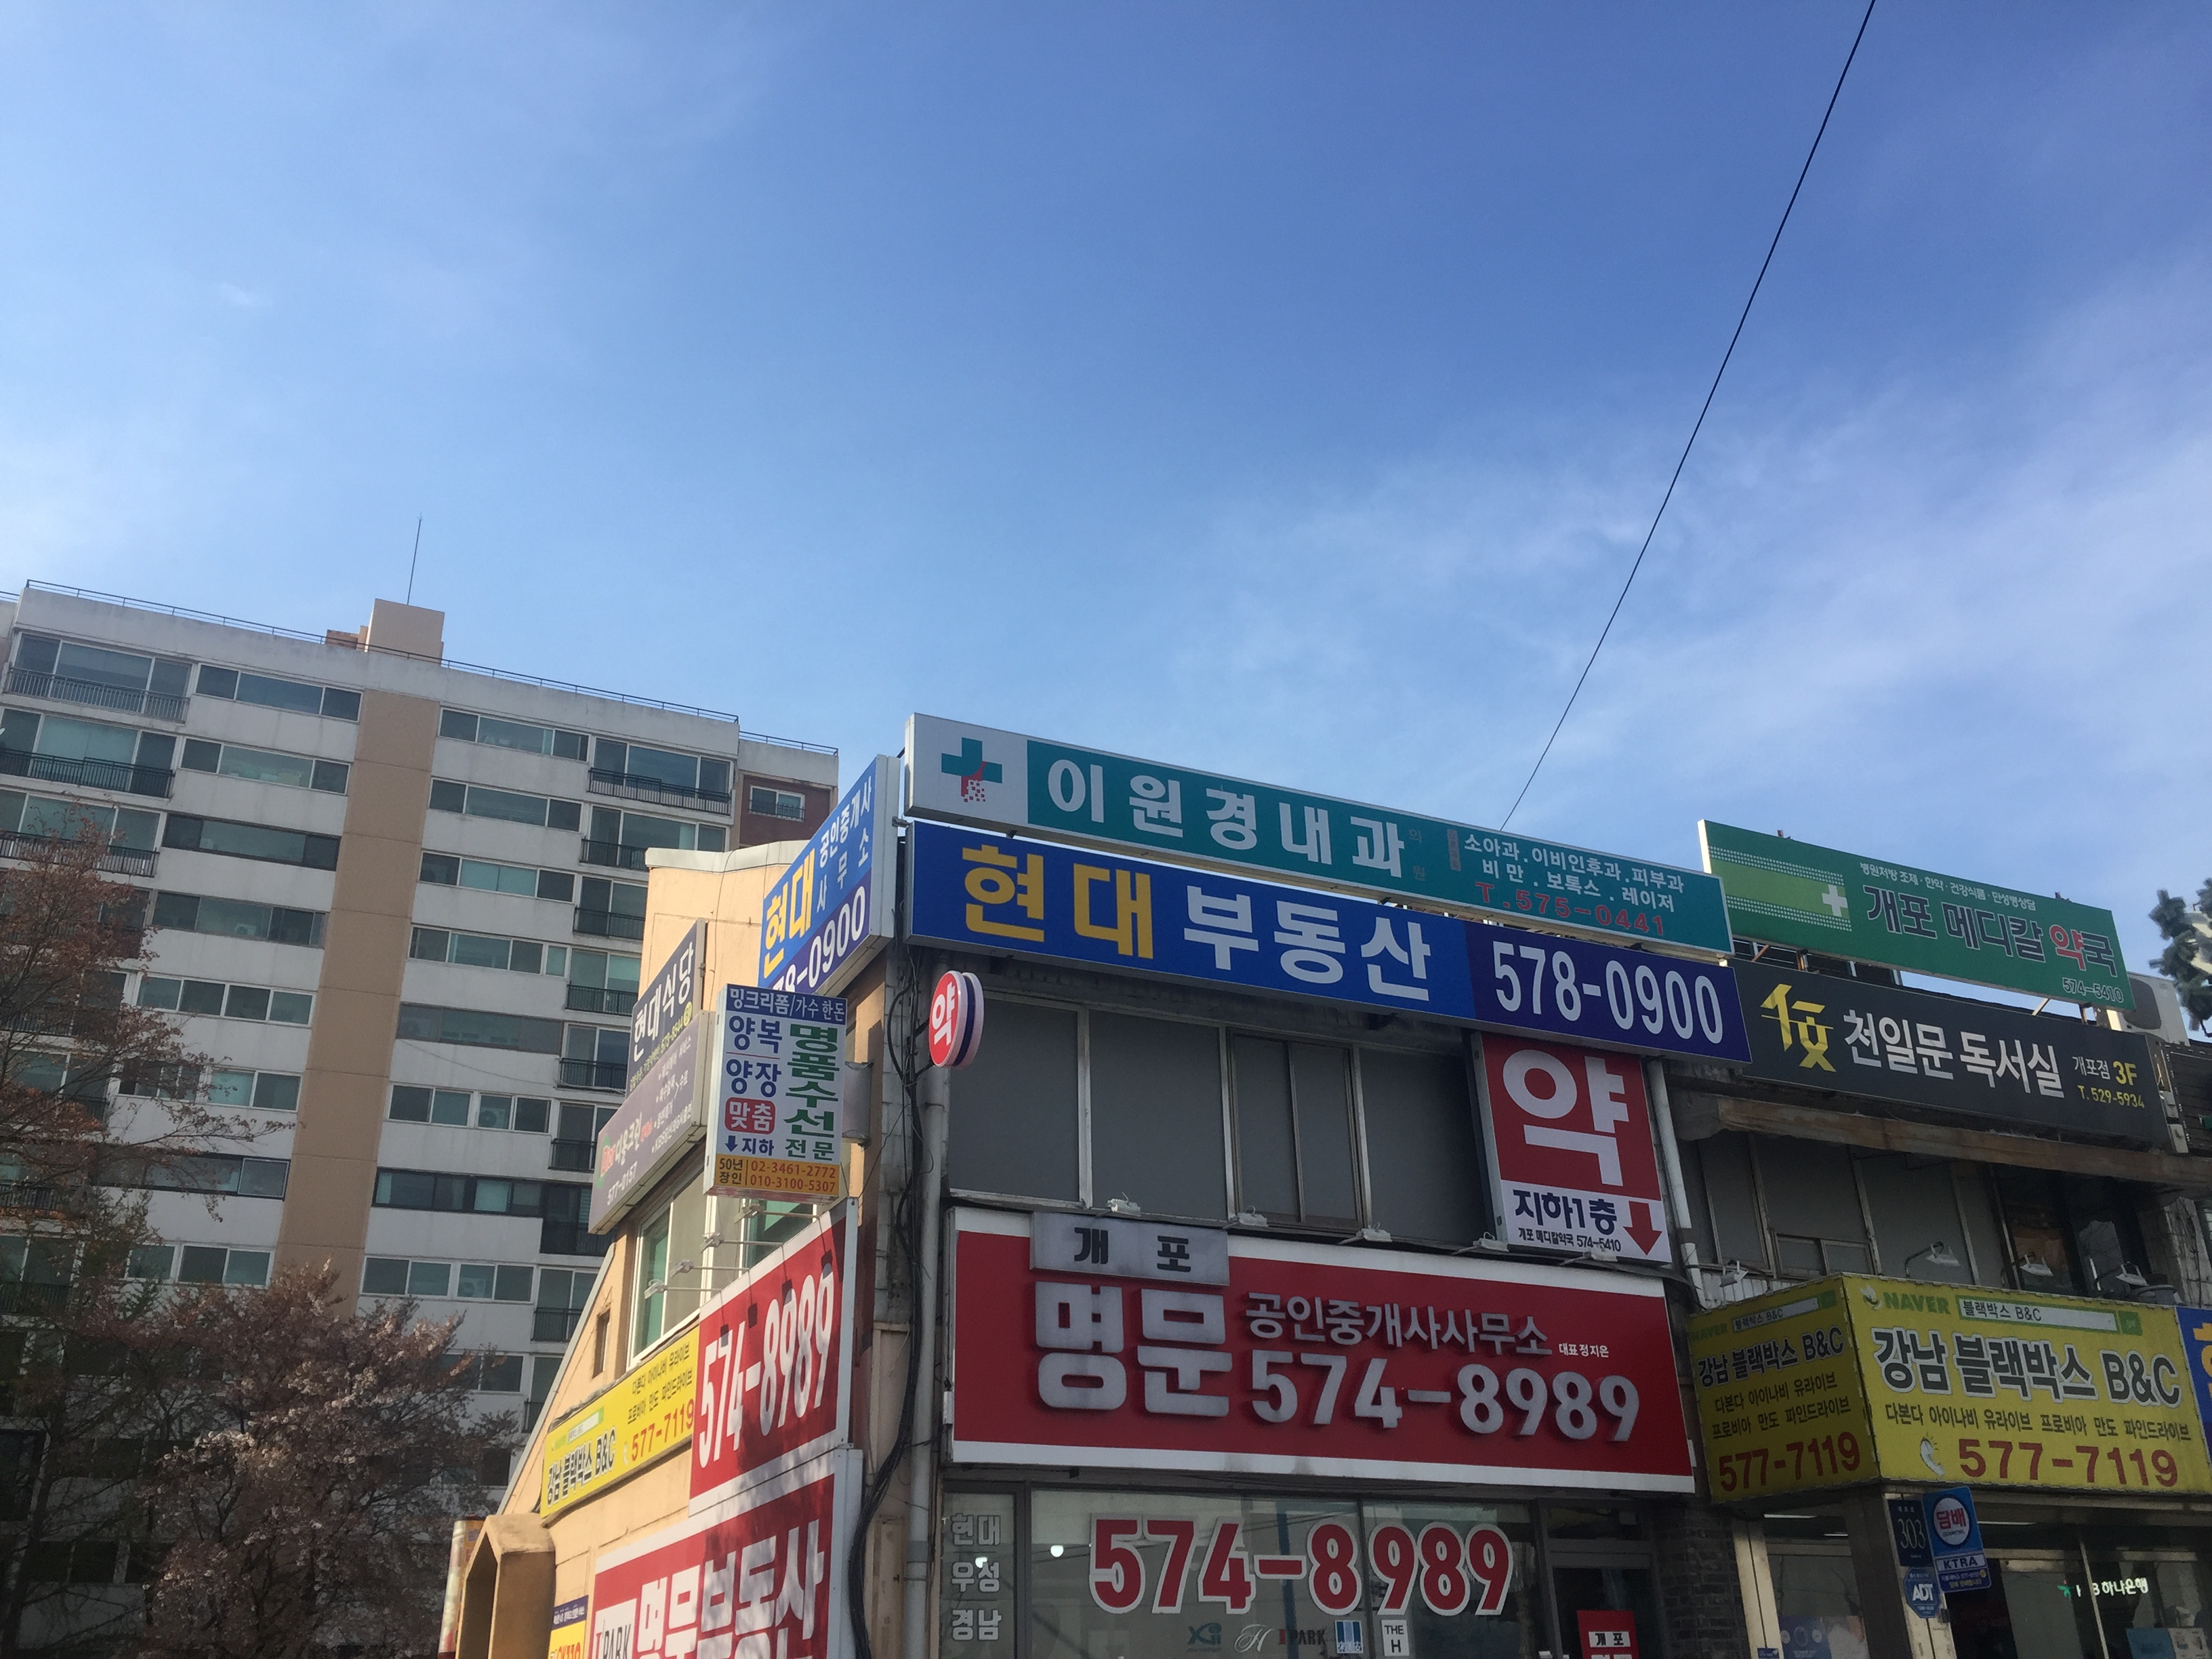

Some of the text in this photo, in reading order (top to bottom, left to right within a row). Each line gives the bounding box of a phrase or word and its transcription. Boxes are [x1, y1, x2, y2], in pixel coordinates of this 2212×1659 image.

[819, 776, 872, 869] 공인중개사
[1048, 758, 1404, 878] 이원경내과
[1547, 872, 1601, 897] 보톡스
[1621, 886, 1674, 913] 레이저
[1860, 862, 1898, 882] 병원처방
[1900, 871, 1919, 886] 조제
[1925, 876, 1944, 891] 한약
[1950, 882, 1986, 900] 건강식품
[763, 848, 815, 978] 현대
[1863, 885, 2118, 977] 개포 메디칼 약국
[962, 844, 1153, 960] 현대
[1184, 885, 1431, 1002] 부동산
[1492, 941, 1723, 1044] 578-0900
[632, 941, 694, 1063] 현대식당
[2062, 977, 2124, 1003] 574-5410
[932, 981, 956, 1046] 약
[729, 1016, 783, 1054] 양복
[1843, 1010, 1954, 1080] 천일문
[1960, 1031, 2065, 1099] 독서실
[2072, 1057, 2110, 1080] 개포점
[2112, 1061, 2137, 1086] 3F
[726, 1059, 781, 1098] 양장
[783, 1023, 840, 1139] 명품수선
[729, 1101, 773, 1132] 맞춤
[1503, 1049, 1629, 1187] 약
[719, 1158, 743, 1171] 50년
[741, 1137, 775, 1156] 지하
[785, 1139, 835, 1161] 전문
[719, 1171, 742, 1185] 장인
[750, 1174, 836, 1193] 010-3100-5307
[751, 1160, 836, 1179] 02-3461-2772
[1513, 1189, 1618, 1235] 지하1층
[1074, 1227, 1191, 1273] 개포
[1518, 1227, 1534, 1242] 개포
[1576, 1235, 1621, 1252] 574-5410
[1766, 1309, 1783, 1321] B&C
[1883, 1292, 2042, 1322] NAVER 블랙박스 B&C
[699, 1262, 834, 1468] 574-8989
[1035, 1281, 1553, 1417] 명문 공인중개사사무소
[1559, 1343, 1609, 1357] 대표 정지은
[1698, 1326, 1845, 1387] 강남 블랙박스 B&C
[1872, 1328, 1952, 1395] 강남
[1953, 1332, 2098, 1403] 블랙박스
[2100, 1349, 2182, 1408] B&C
[1251, 1349, 1640, 1442] 574-8989
[1715, 1372, 1838, 1414] 다본다 아이나비 유라이브
[631, 1398, 695, 1462] 577-7119
[1712, 1396, 1851, 1439] 프로비아 만도 파인드라이브
[1886, 1404, 2192, 1442] 다본다 아이나비 유라이브 프로비아 만도 파인드라이브
[548, 1426, 615, 1508] 강남 블랙박스 B&C
[1719, 1431, 1860, 1492] 577-7119
[1959, 1438, 2178, 1488] 577-7119
[951, 1513, 1001, 1546] 현대
[1898, 1518, 1926, 1549] 303
[1936, 1507, 1966, 1530] 담배
[951, 1561, 1000, 1593] 우성
[1090, 1514, 1513, 1616] 574-8989
[1943, 1557, 1978, 1570] KTRA
[1912, 1583, 1933, 1601] ADT
[951, 1608, 1002, 1641] 경남
[1384, 1625, 1404, 1635] THE
[1595, 1633, 1624, 1646] 개포
[1391, 1639, 1401, 1653] H
